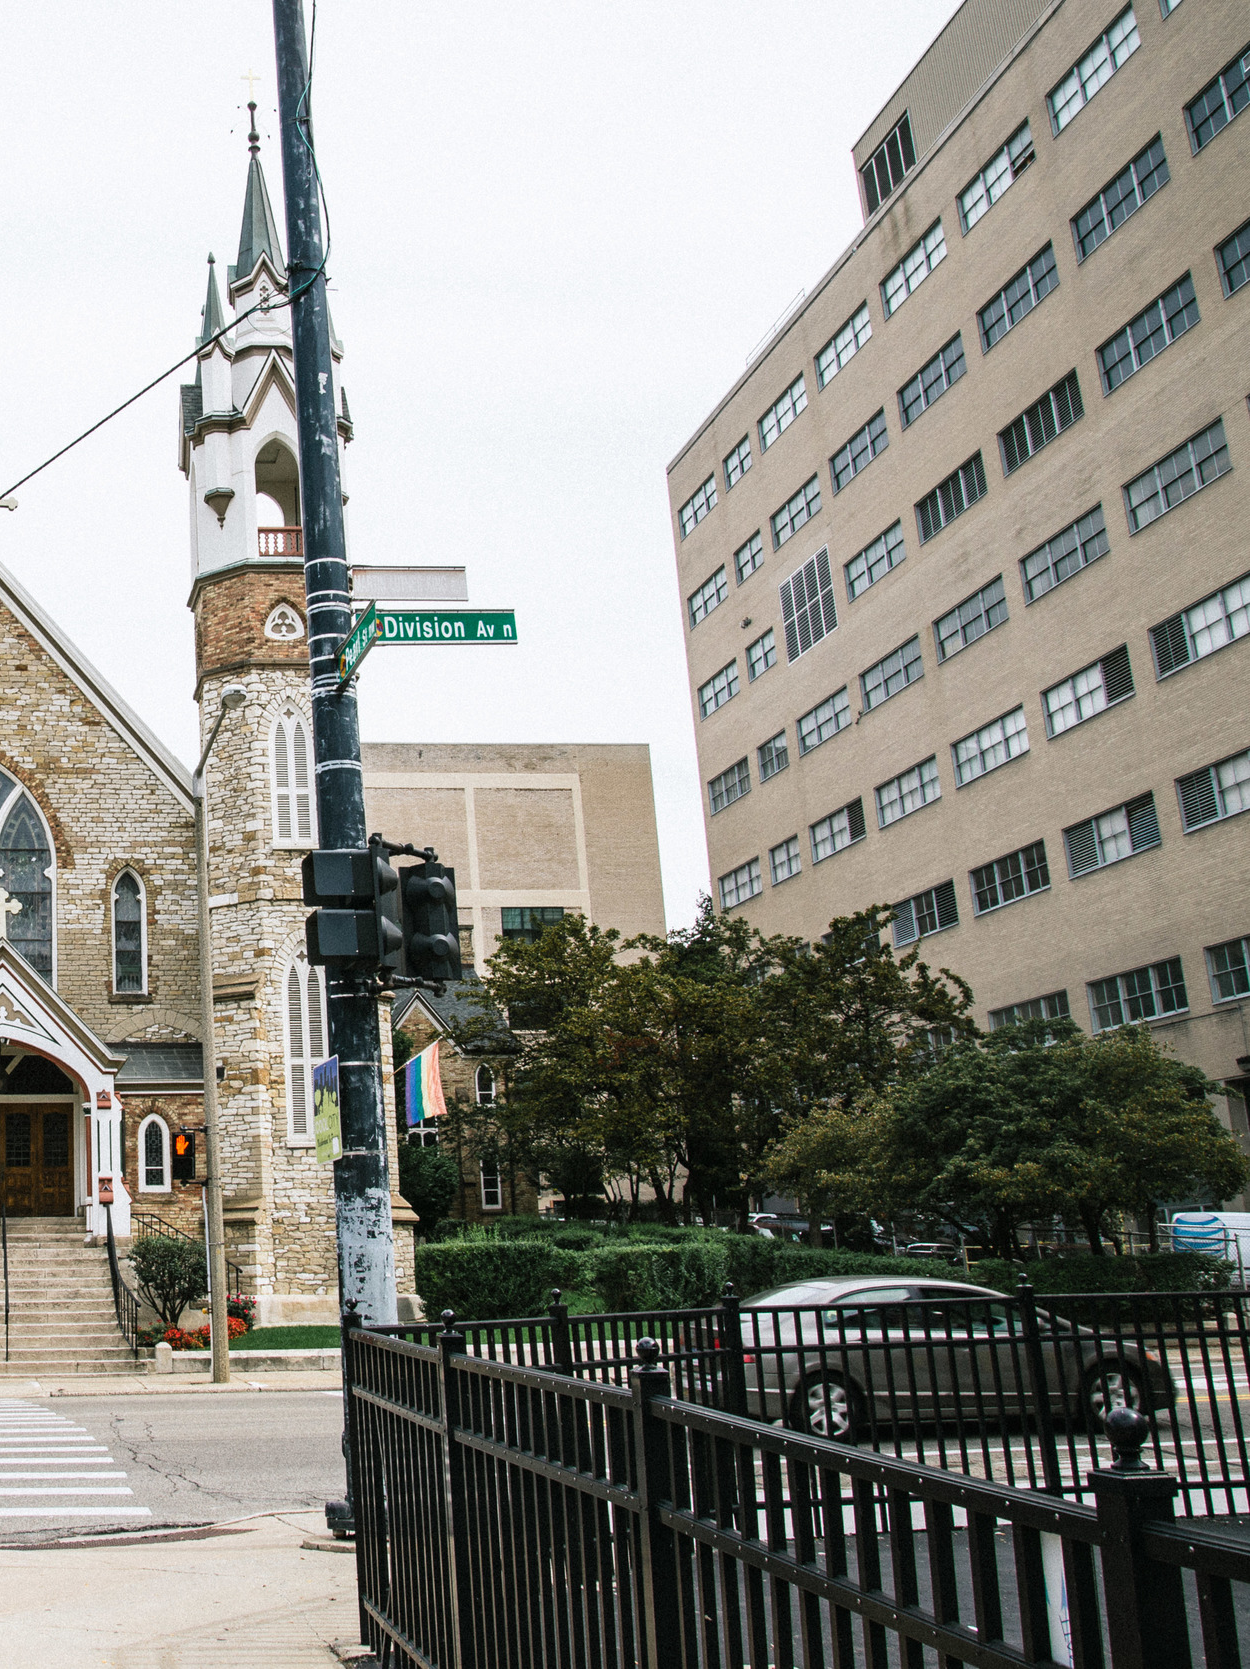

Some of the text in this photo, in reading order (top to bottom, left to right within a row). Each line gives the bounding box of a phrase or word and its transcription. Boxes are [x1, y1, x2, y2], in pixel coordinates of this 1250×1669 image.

[383, 616, 513, 639] Division Av n
[345, 630, 361, 671] Pearl
